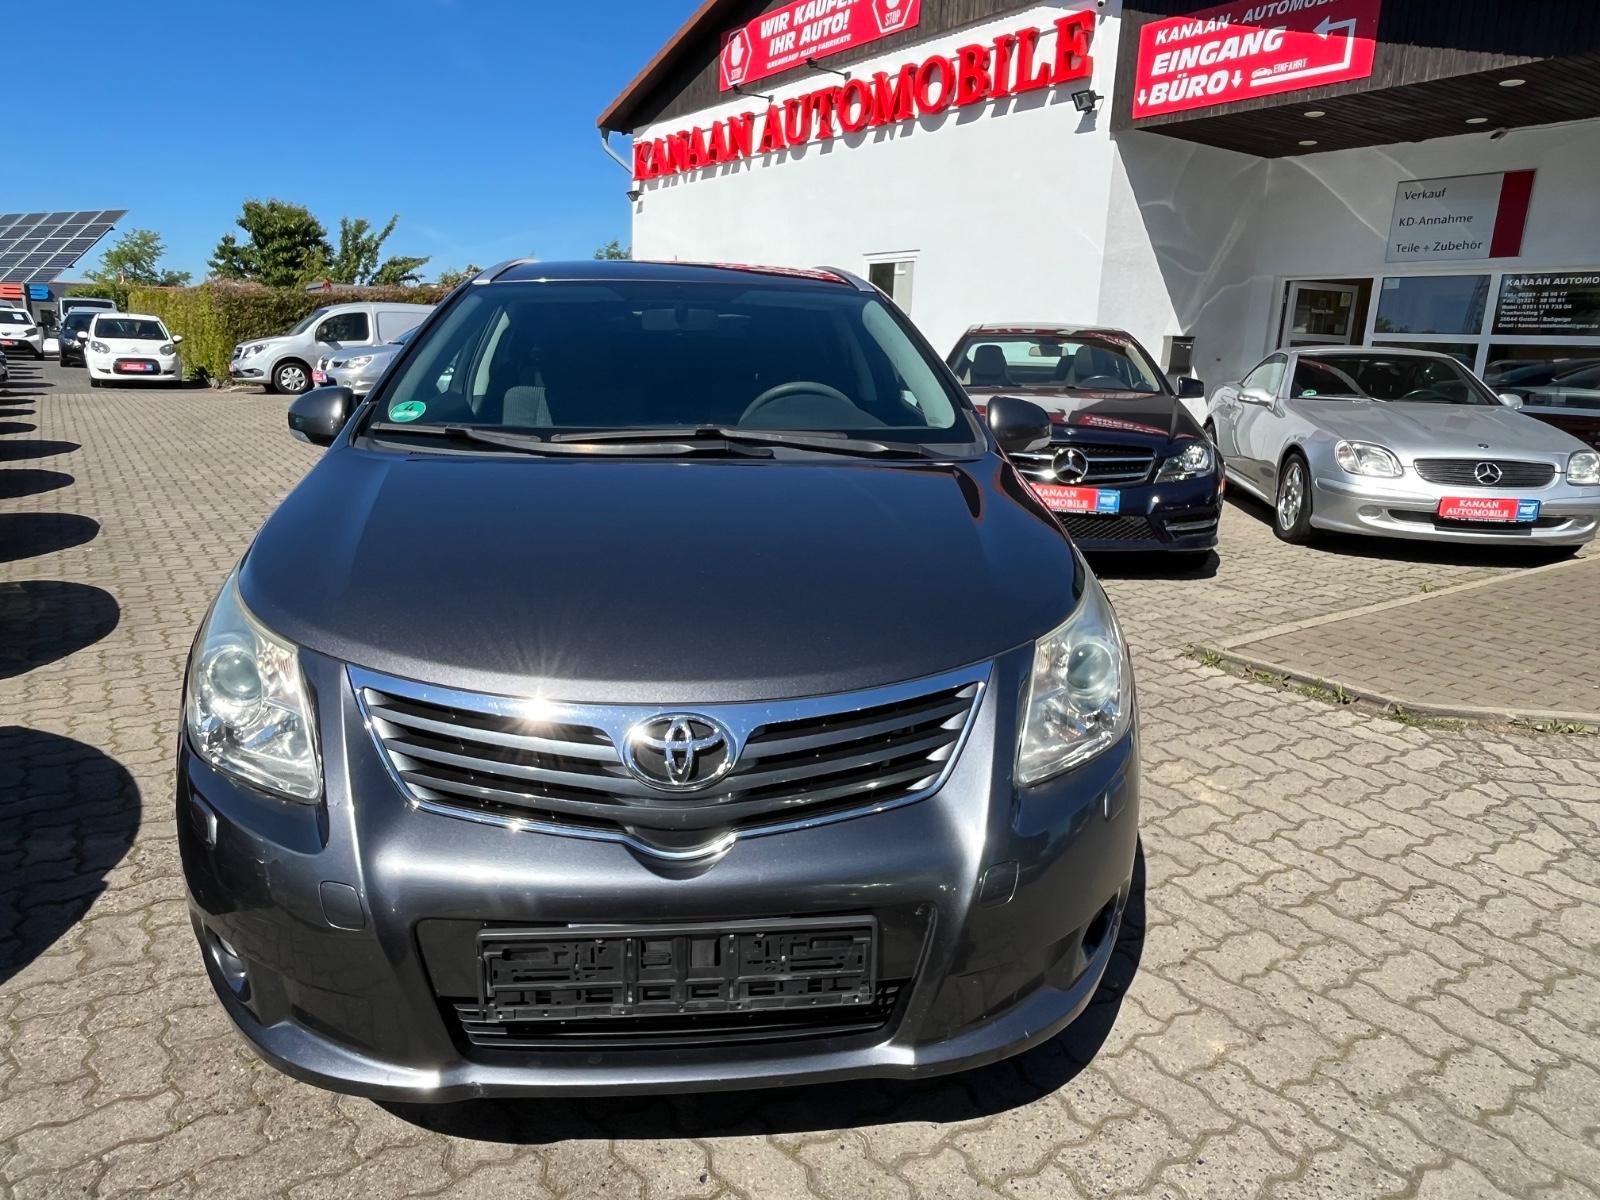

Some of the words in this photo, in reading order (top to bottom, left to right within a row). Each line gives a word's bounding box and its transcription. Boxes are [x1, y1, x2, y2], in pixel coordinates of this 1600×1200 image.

[760, 12, 790, 39] WIR
[885, 10, 901, 26] STOP
[768, 31, 797, 57] IHR
[799, 9, 850, 46] AUTO!
[1155, 15, 1230, 46] KANAAN
[799, 45, 817, 58] ALLER
[817, 33, 852, 52] FABRIKATE
[1151, 26, 1287, 77] EINGANG
[633, 111, 755, 180] KANAAN
[758, 9, 1099, 154] AUTOMOBILE
[1148, 69, 1229, 106] BÜRO
[1404, 187, 1447, 201] Verkauf
[1398, 214, 1474, 227] KD-Annahme
[1395, 243, 1420, 253] Teile
[1432, 239, 1483, 252] Zubehör
[1506, 278, 1550, 287] KANAAN
[1036, 488, 1077, 498] KANAAN
[1446, 507, 1509, 518] AUTOMOBILE
[1459, 500, 1499, 509] KANAAN
